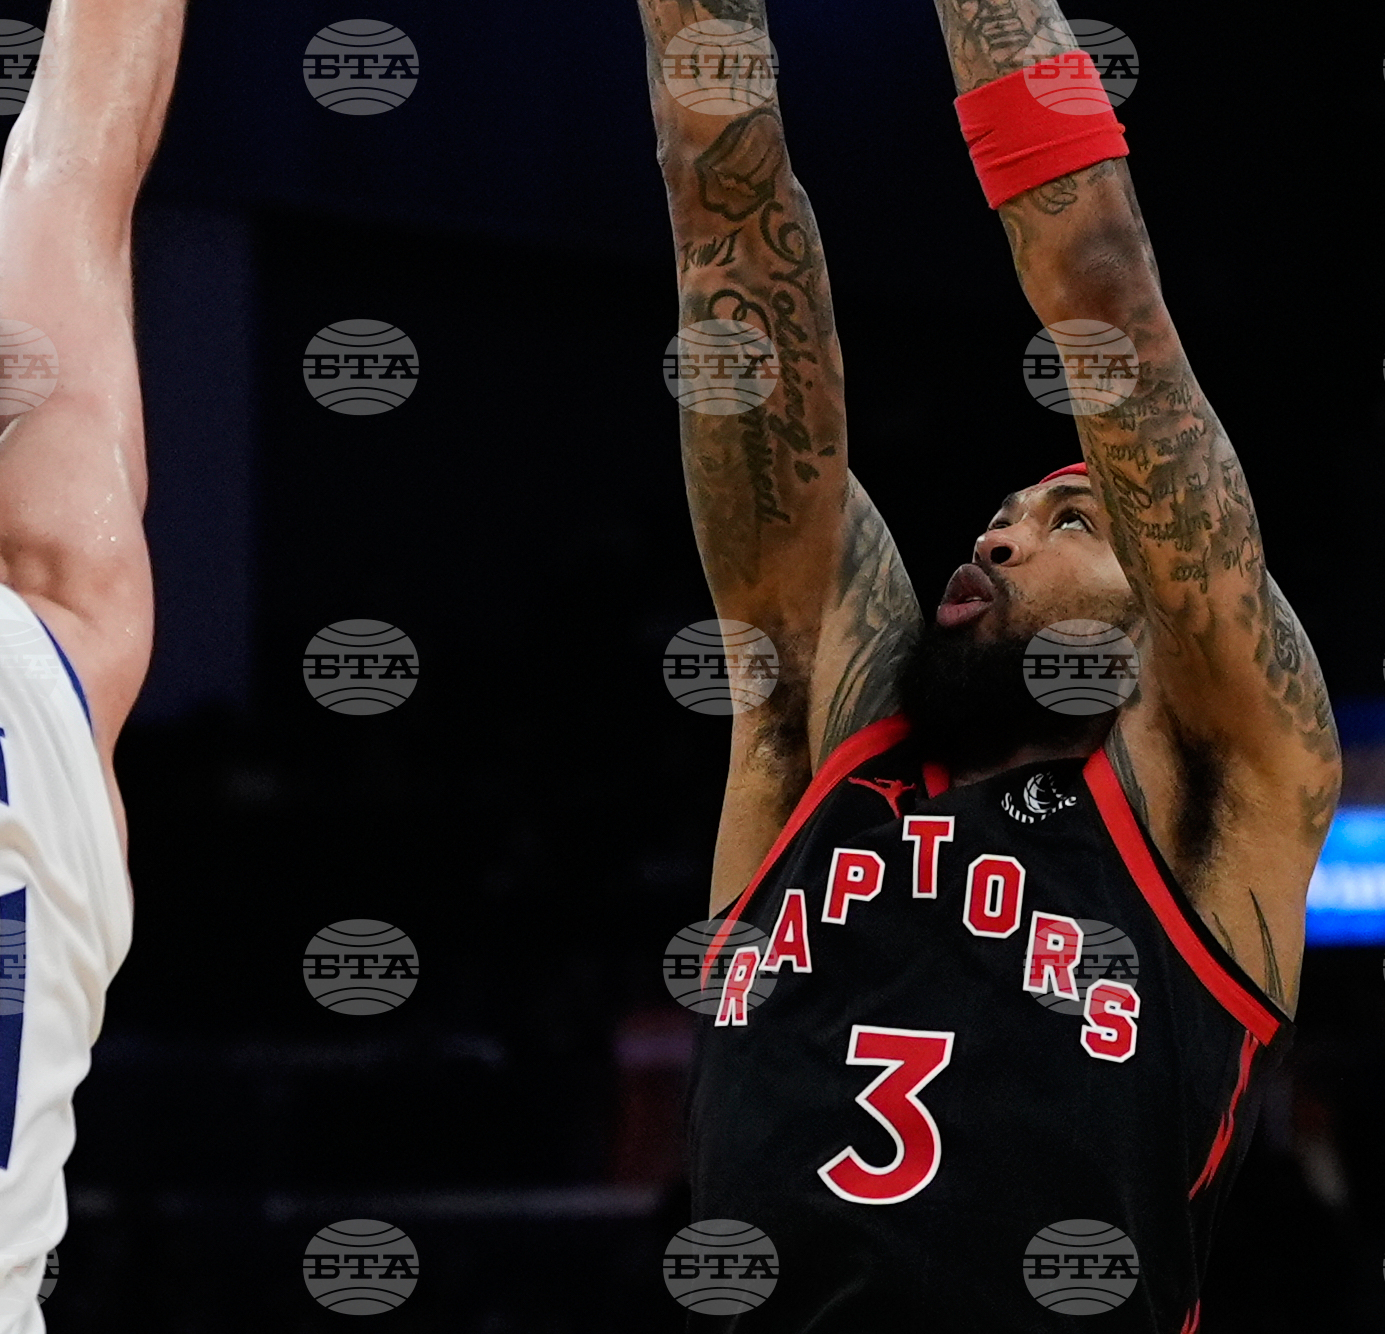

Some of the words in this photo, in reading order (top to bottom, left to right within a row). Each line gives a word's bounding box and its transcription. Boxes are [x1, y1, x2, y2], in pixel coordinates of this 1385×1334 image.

[1001, 792, 1034, 824] Sun
[715, 815, 1141, 1063] RAPTORS
[816, 1025, 955, 1205] 3
